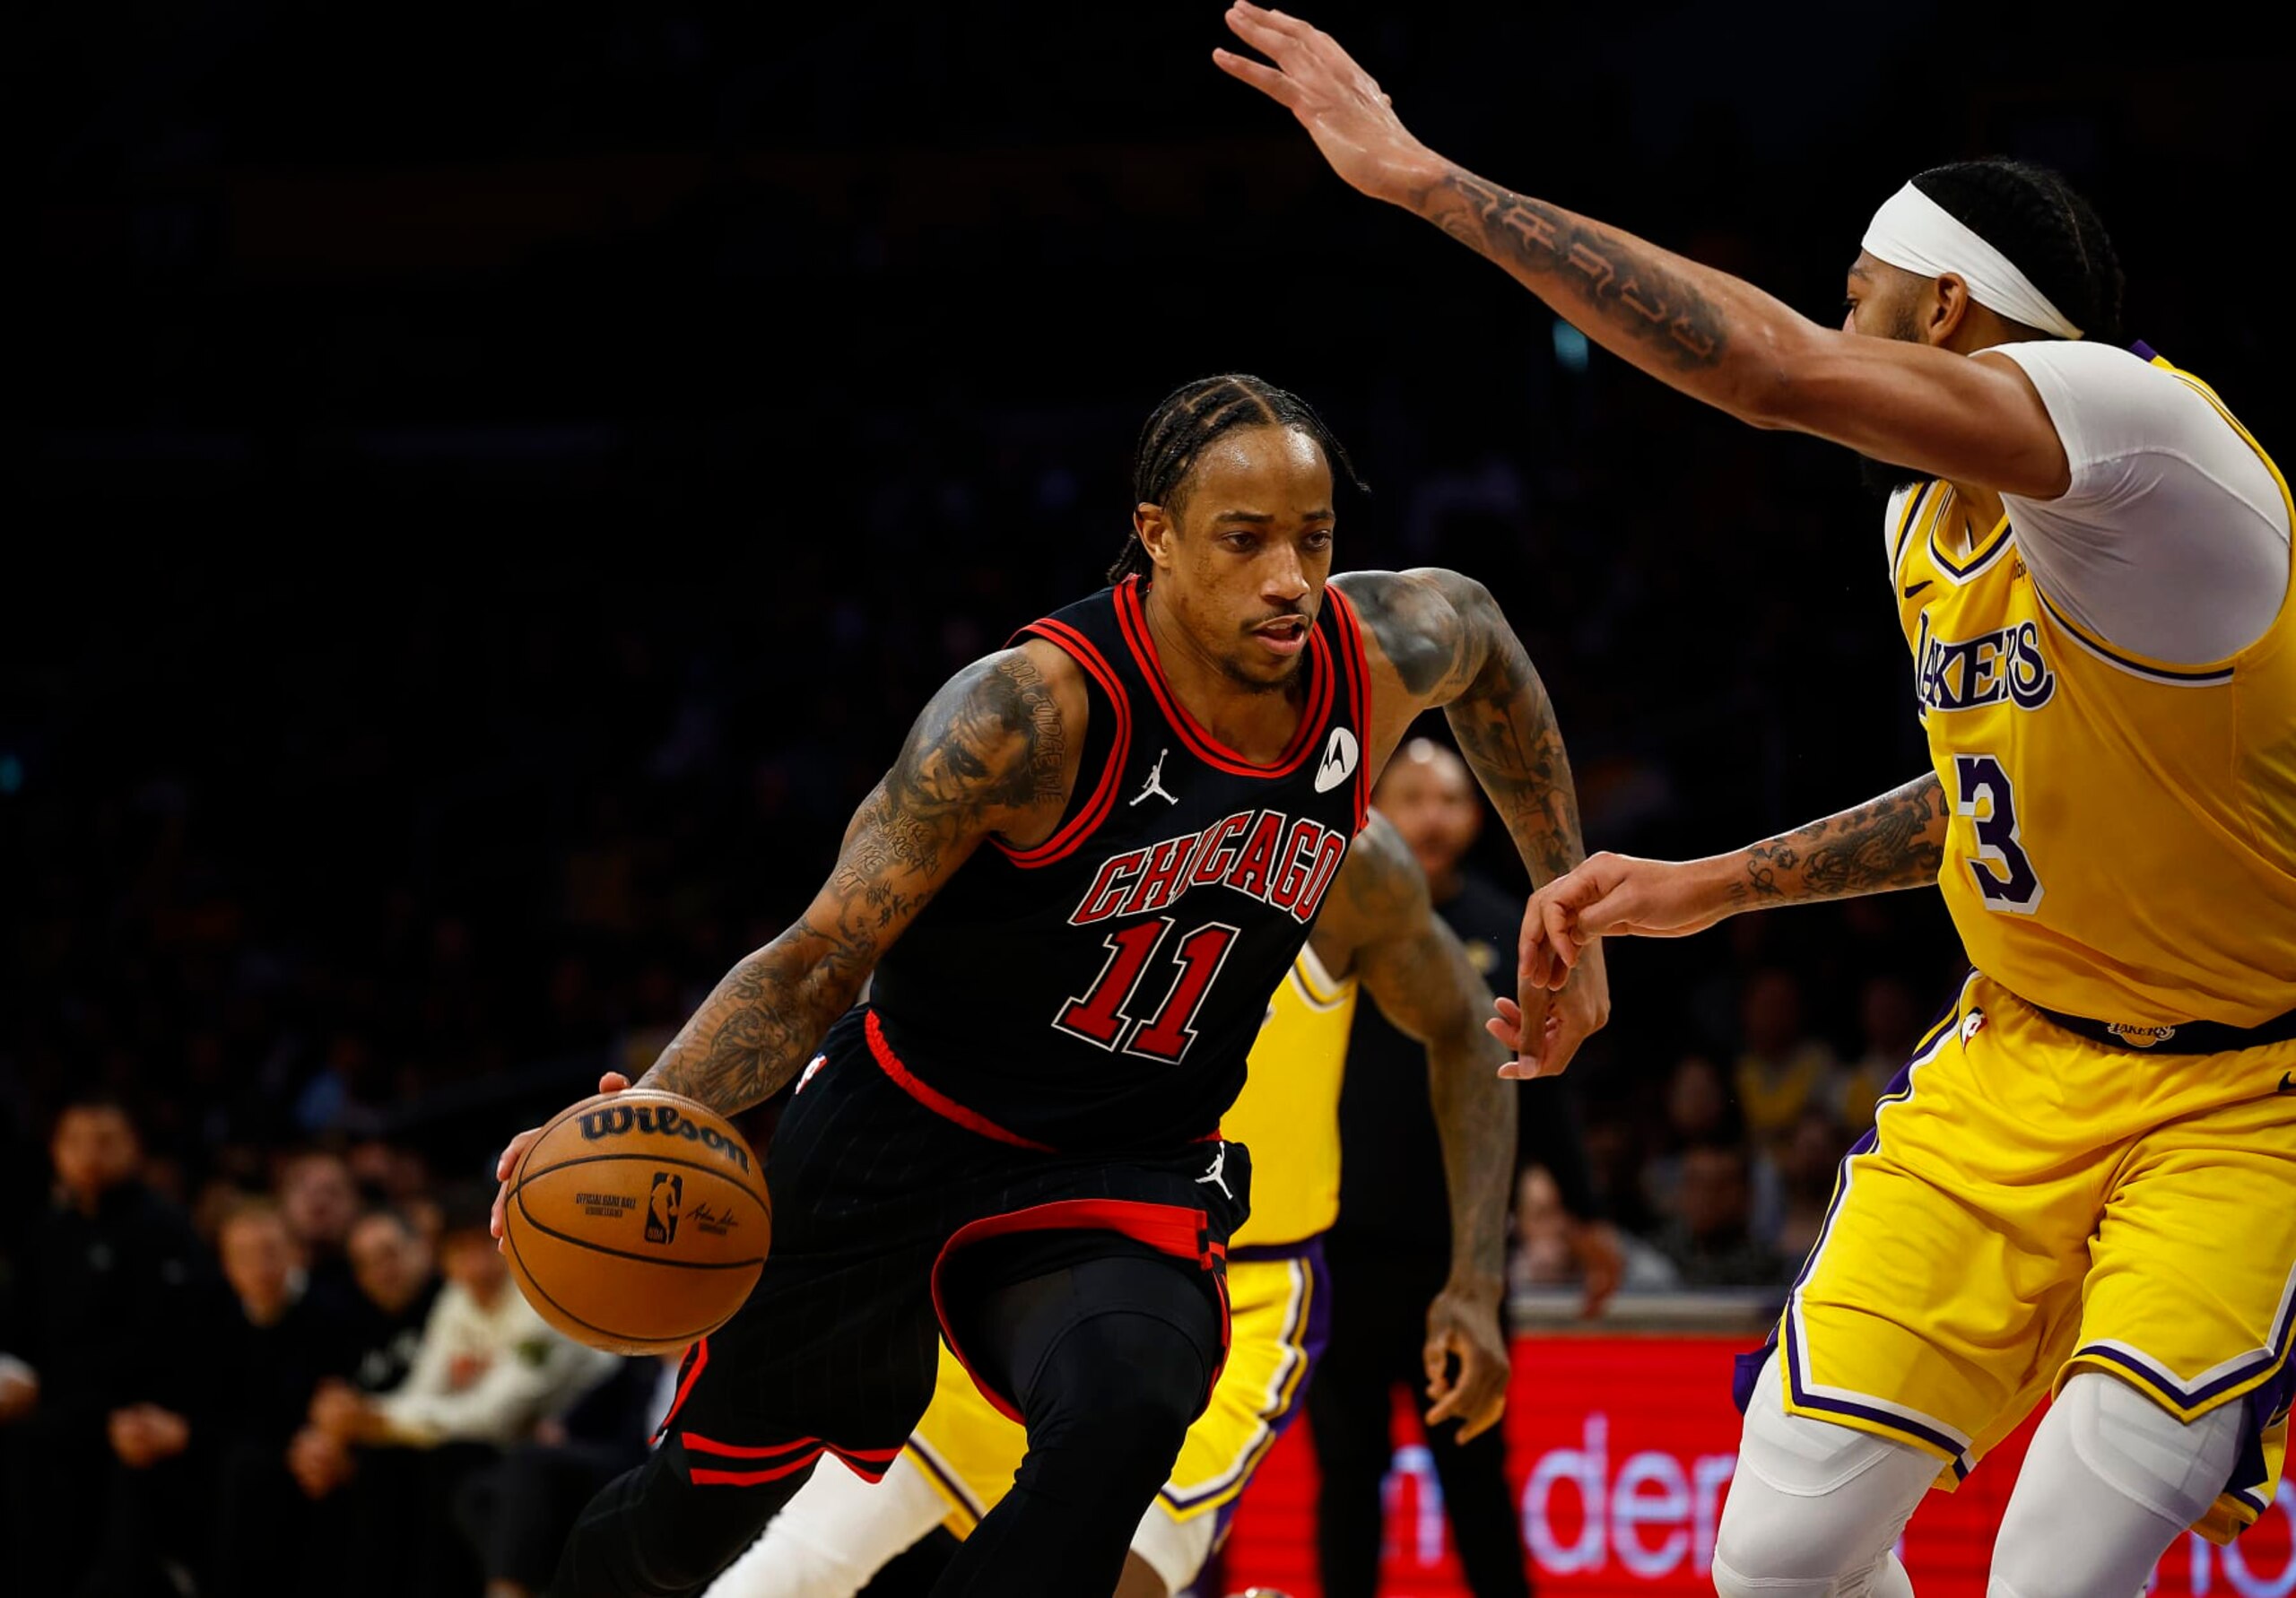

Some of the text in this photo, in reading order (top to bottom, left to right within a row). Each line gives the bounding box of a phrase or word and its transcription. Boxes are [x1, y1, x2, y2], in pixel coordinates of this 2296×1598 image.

[1067, 809, 1346, 925] CHICAGO
[1953, 752, 2045, 915] 3
[1051, 916, 1241, 1065] 11
[578, 1105, 752, 1177] Wilson
